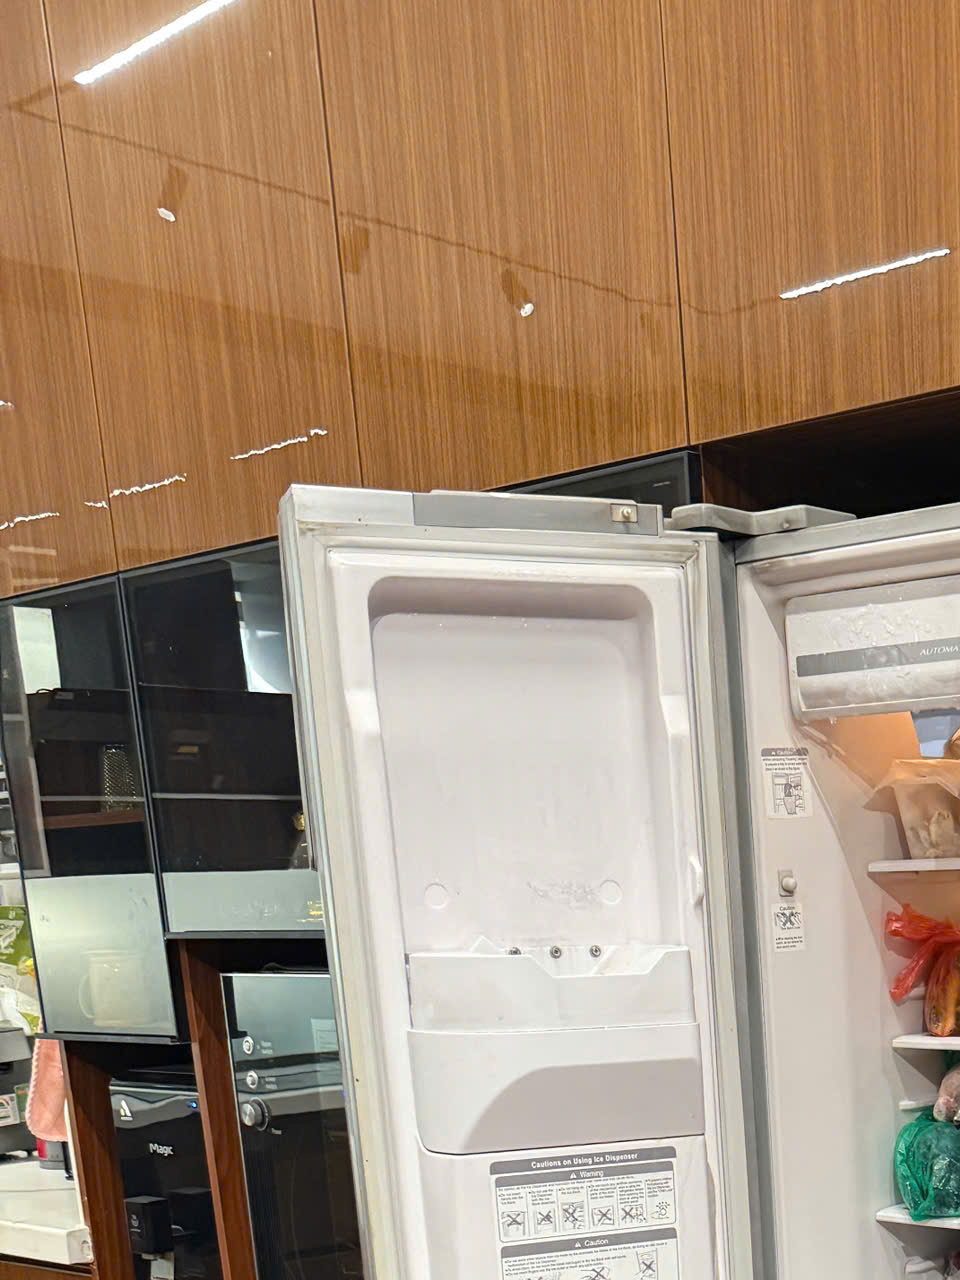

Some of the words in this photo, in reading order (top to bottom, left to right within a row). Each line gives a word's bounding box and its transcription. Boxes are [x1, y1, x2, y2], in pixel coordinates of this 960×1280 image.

[149, 1143, 173, 1157] Magic
[531, 1160, 561, 1169] Cautions
[563, 1158, 572, 1166] on
[573, 1156, 592, 1165] Using
[593, 1155, 604, 1163] Ice
[605, 1153, 638, 1163] Dispenser
[579, 1170, 604, 1178] Warning
[584, 1238, 609, 1247] Caution
